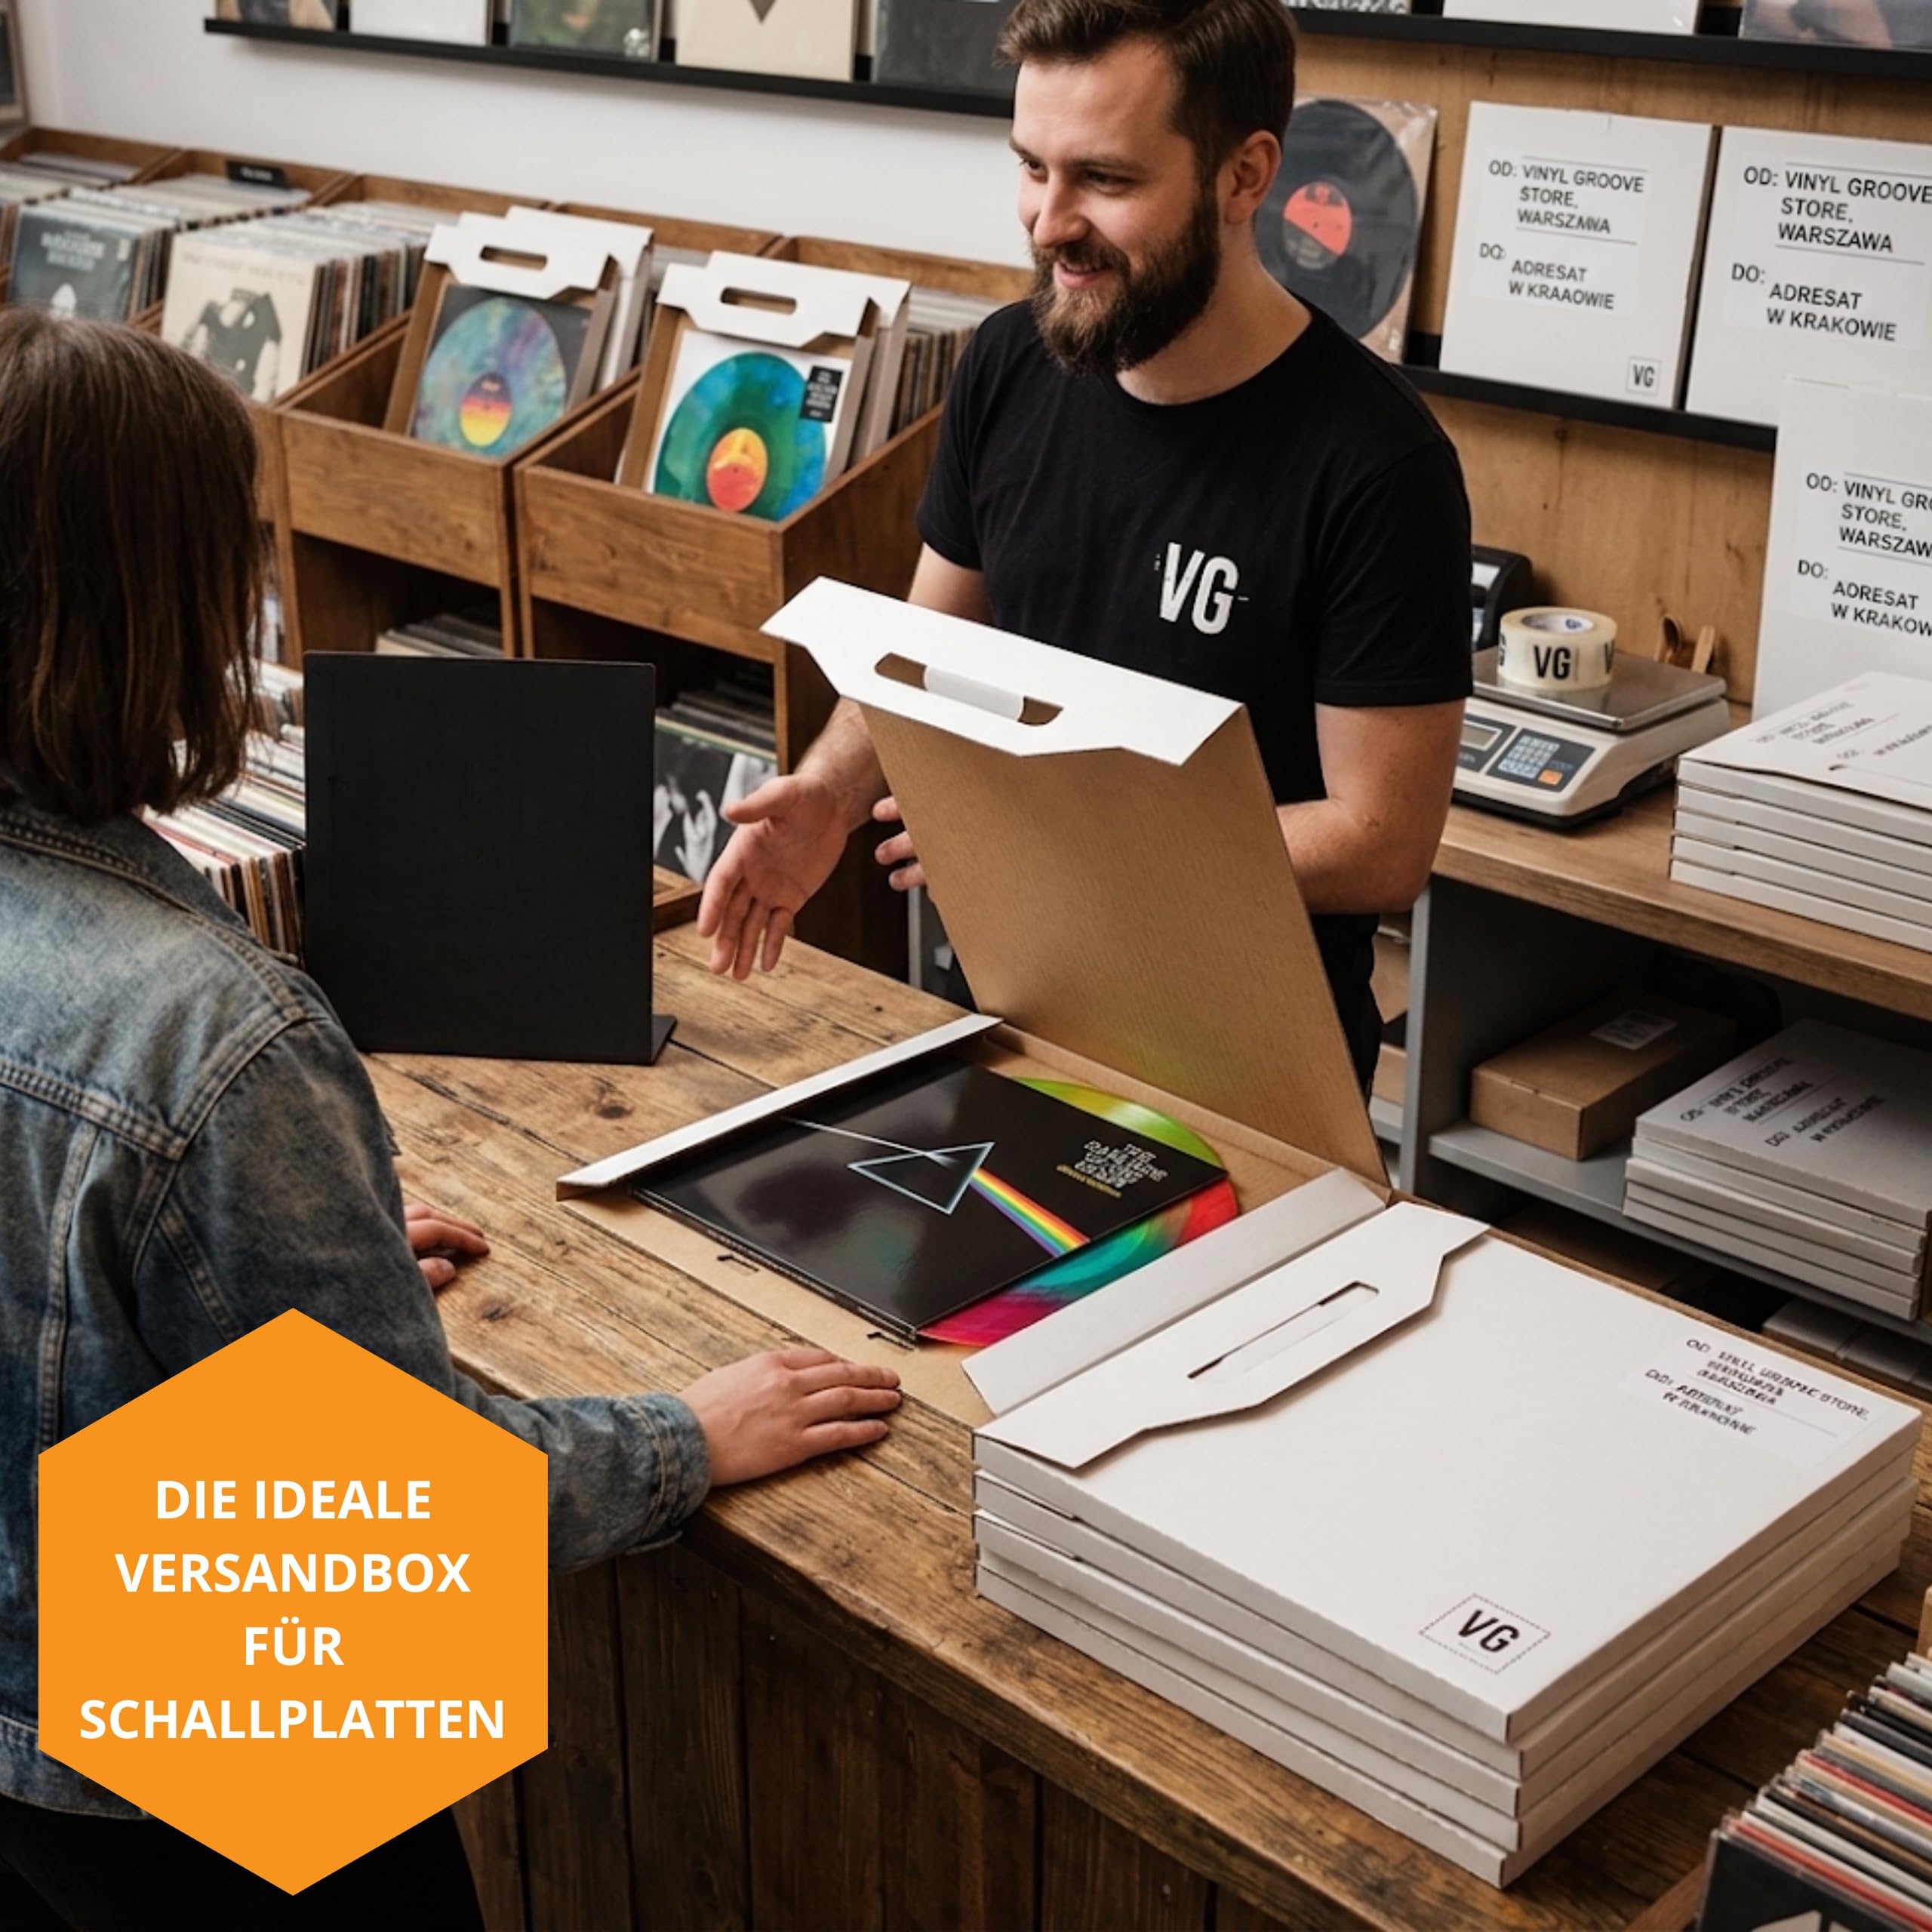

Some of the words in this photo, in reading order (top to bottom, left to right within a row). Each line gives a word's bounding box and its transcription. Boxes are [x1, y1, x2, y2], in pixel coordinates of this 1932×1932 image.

[1522, 165, 1568, 184] VINYL
[1574, 170, 1644, 192] GROOVE
[1743, 166, 1778, 186] OD:
[1785, 170, 1840, 194] VINYL
[1847, 177, 1932, 204] GROOVE
[1778, 223, 1893, 253] WARSZAWA
[1512, 260, 1587, 282] ADRESAT
[1731, 263, 1765, 285] DO:
[1509, 281, 1524, 296] W
[1769, 283, 1862, 310] ADRESAT
[1767, 308, 1785, 325] W
[1789, 311, 1897, 342] KRAKOWIE
[1633, 364, 1656, 388] VG
[1844, 480, 1895, 505] VINYL
[1901, 491, 1932, 511] GR
[1798, 559, 1829, 580] DO:
[1160, 542, 1239, 635] VG
[1831, 602, 1849, 620] W
[1534, 645, 1571, 681] VG
[1458, 1609, 1520, 1653] VG
